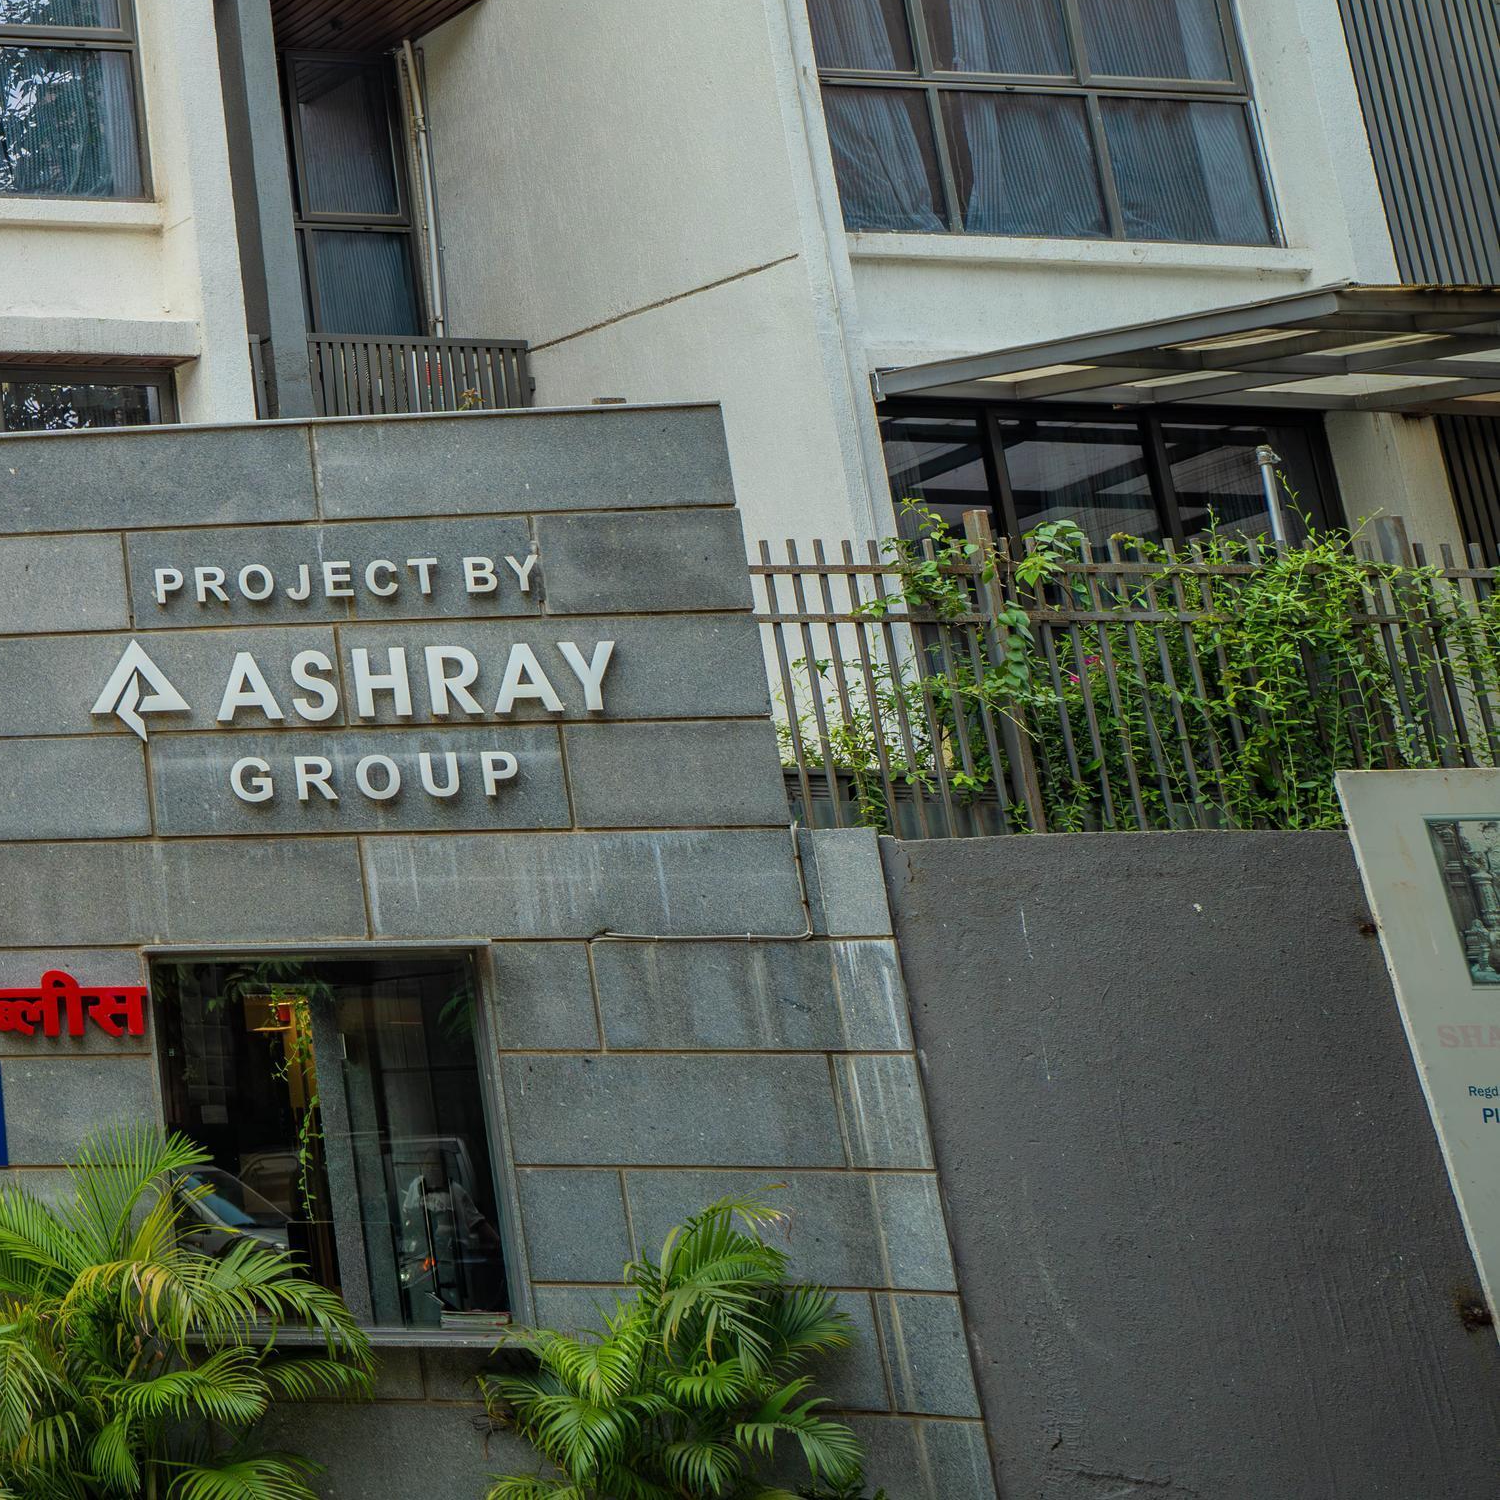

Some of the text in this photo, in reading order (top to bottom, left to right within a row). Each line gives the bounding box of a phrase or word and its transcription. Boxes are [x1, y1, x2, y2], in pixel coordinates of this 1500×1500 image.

[154, 554, 539, 605] PROJECT BY
[216, 640, 616, 722] ASHRAY
[229, 750, 518, 803] GROUP
